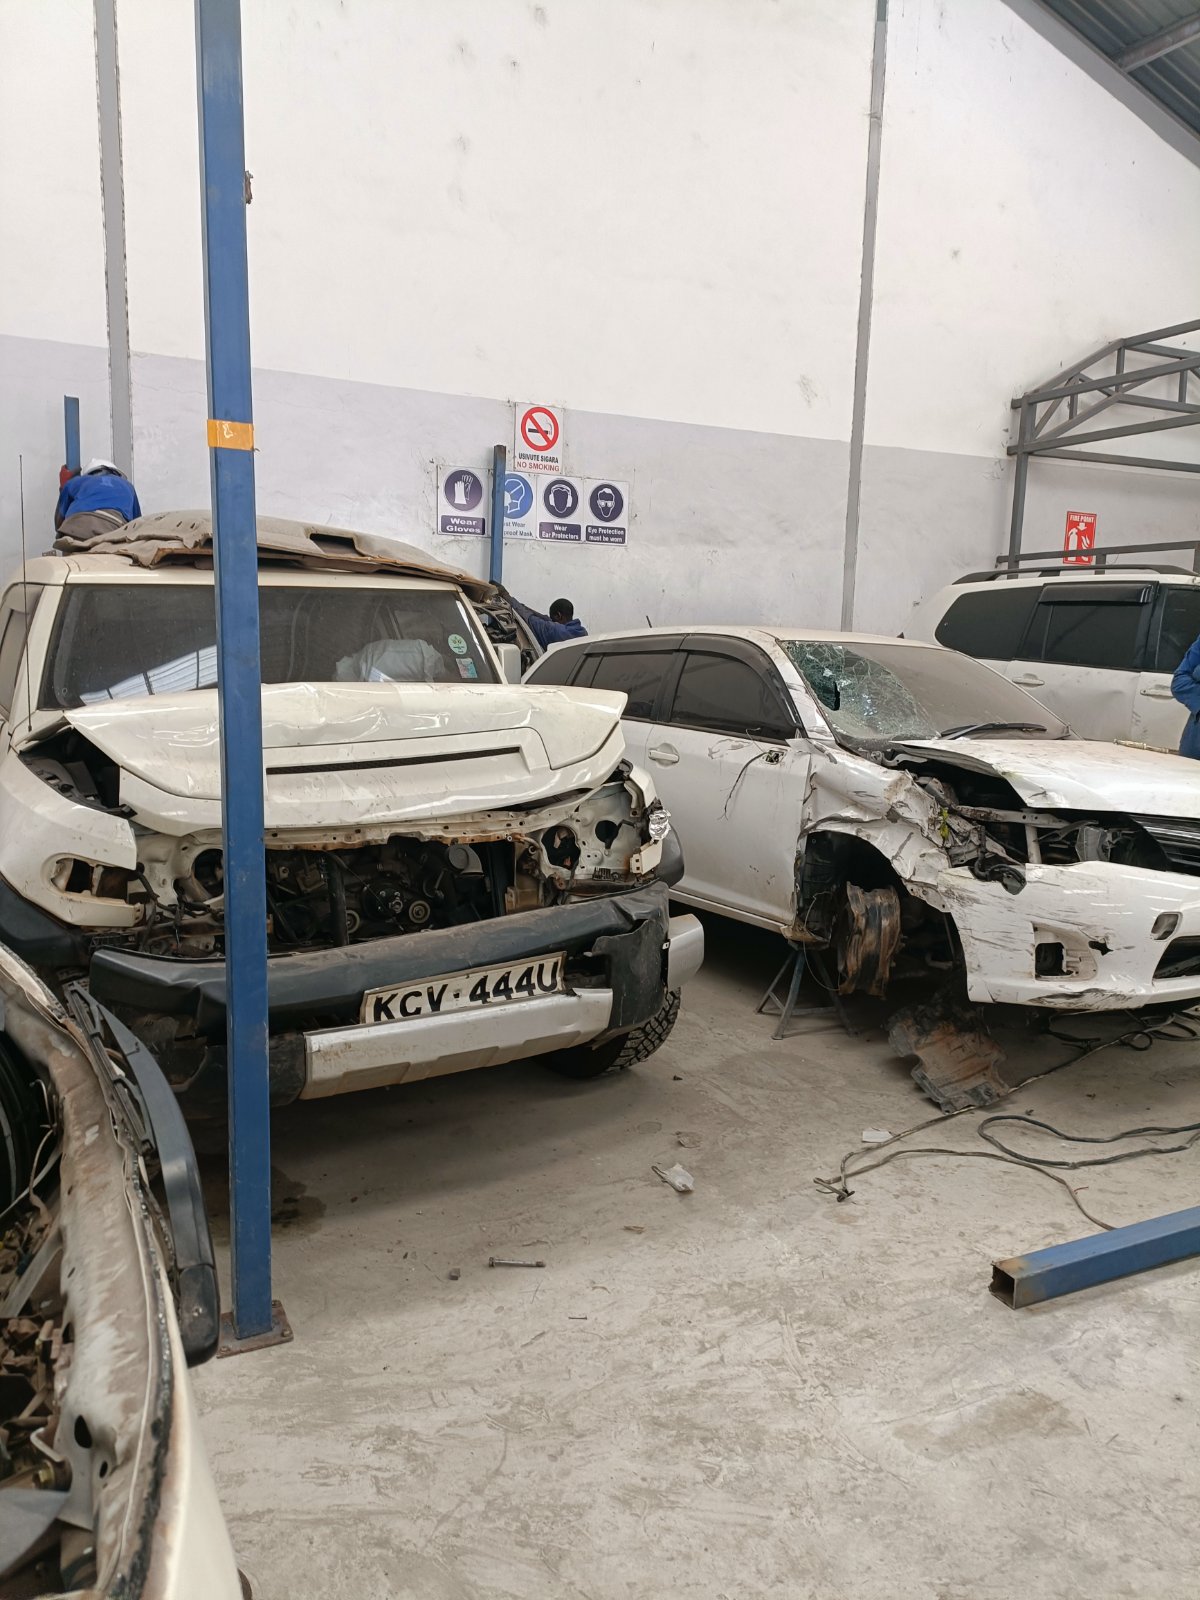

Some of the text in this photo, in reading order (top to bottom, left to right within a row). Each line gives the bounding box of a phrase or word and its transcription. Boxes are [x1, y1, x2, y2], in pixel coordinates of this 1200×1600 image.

[518, 452, 559, 464] USIVUTE SIGARA
[528, 462, 560, 472] SMOKING
[450, 517, 478, 526] Wear
[446, 525, 481, 533] Gloves
[553, 524, 568, 532] Wear
[587, 526, 598, 535] Eye
[551, 531, 579, 540] Protectors
[373, 961, 559, 1022] KCV 444U
